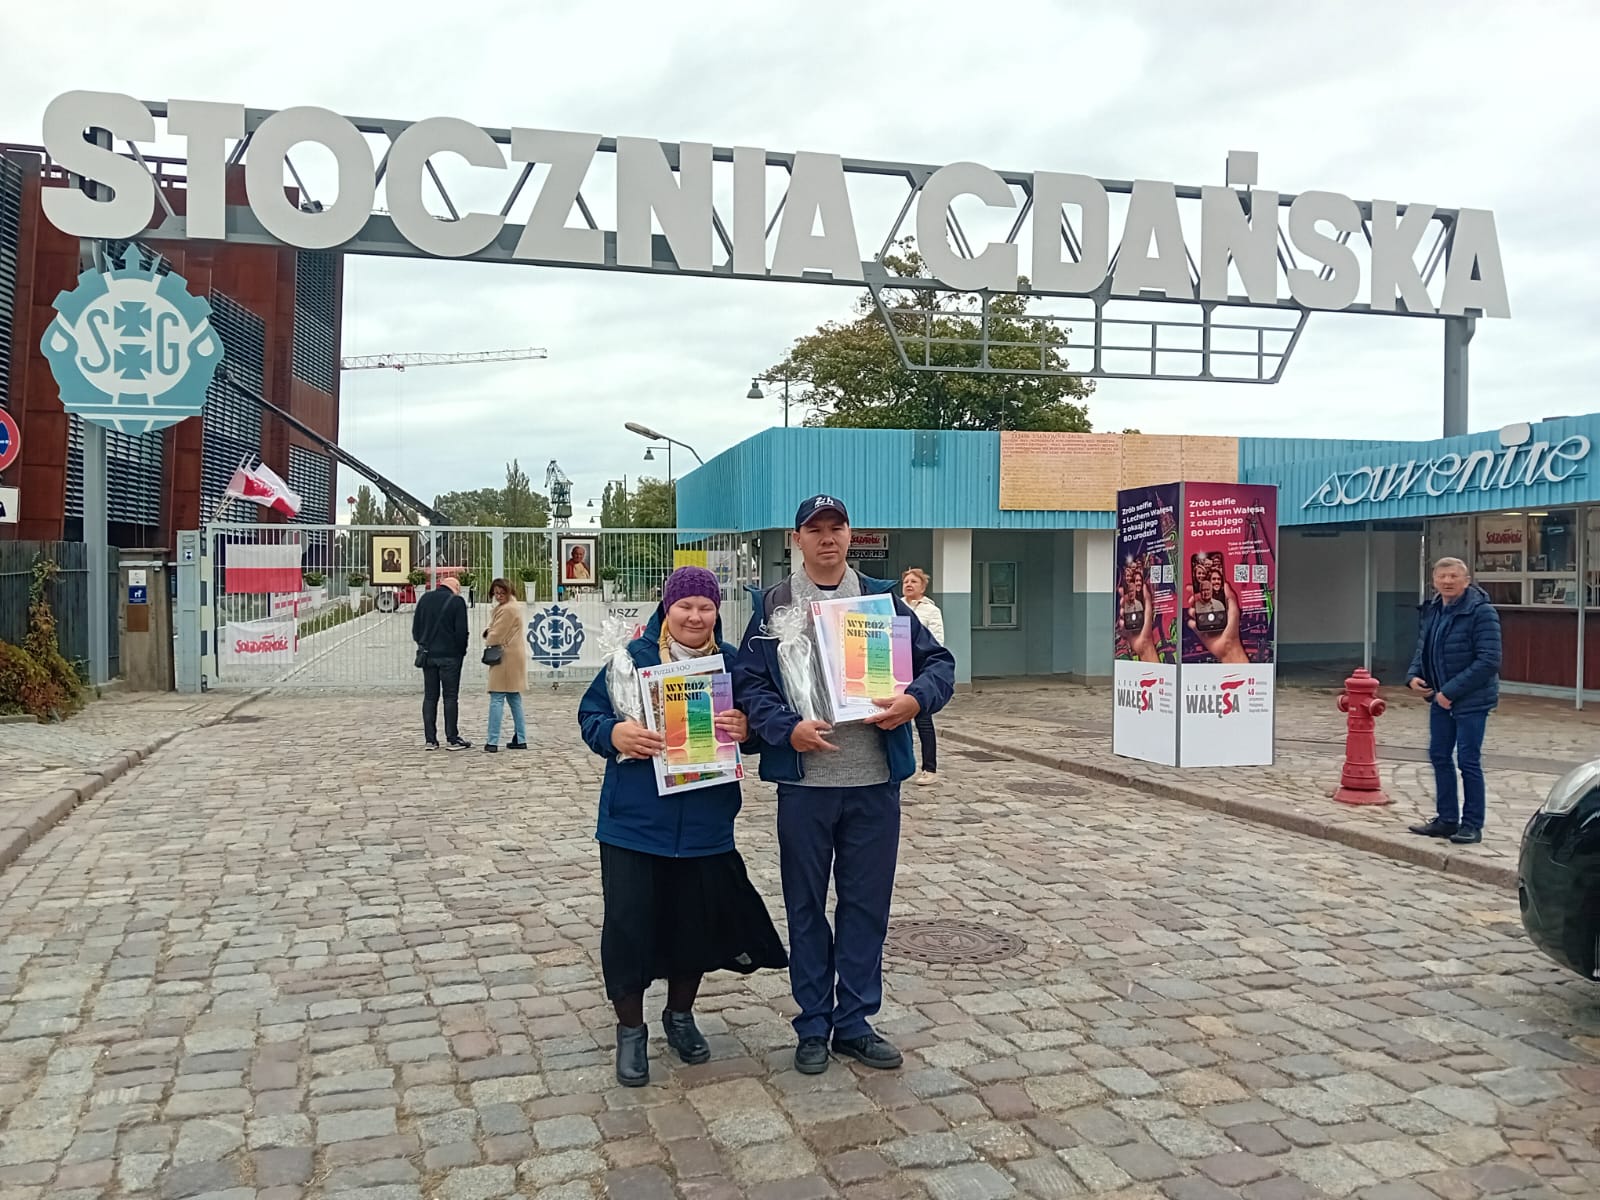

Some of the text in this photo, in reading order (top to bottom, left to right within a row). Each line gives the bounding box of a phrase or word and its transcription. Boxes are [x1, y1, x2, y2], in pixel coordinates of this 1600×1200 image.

[41, 89, 1511, 319] STOCZNIA GDAŃSKA
[1136, 500, 1153, 511] selfie
[1189, 497, 1237, 508] Zrób selfie
[1196, 508, 1232, 517] Lechem
[1232, 506, 1266, 516] Wałęsą
[1127, 512, 1150, 523] Lechem
[1196, 517, 1223, 527] okazji
[1223, 517, 1244, 527] jego
[1190, 529, 1204, 537] 80
[608, 608, 639, 619] NSZZ
[1186, 684, 1217, 692] LECH
[665, 690, 703, 703] NIENIE
[1117, 688, 1154, 715] WAŁĘSA
[1185, 692, 1240, 719] WAŁĘSA
